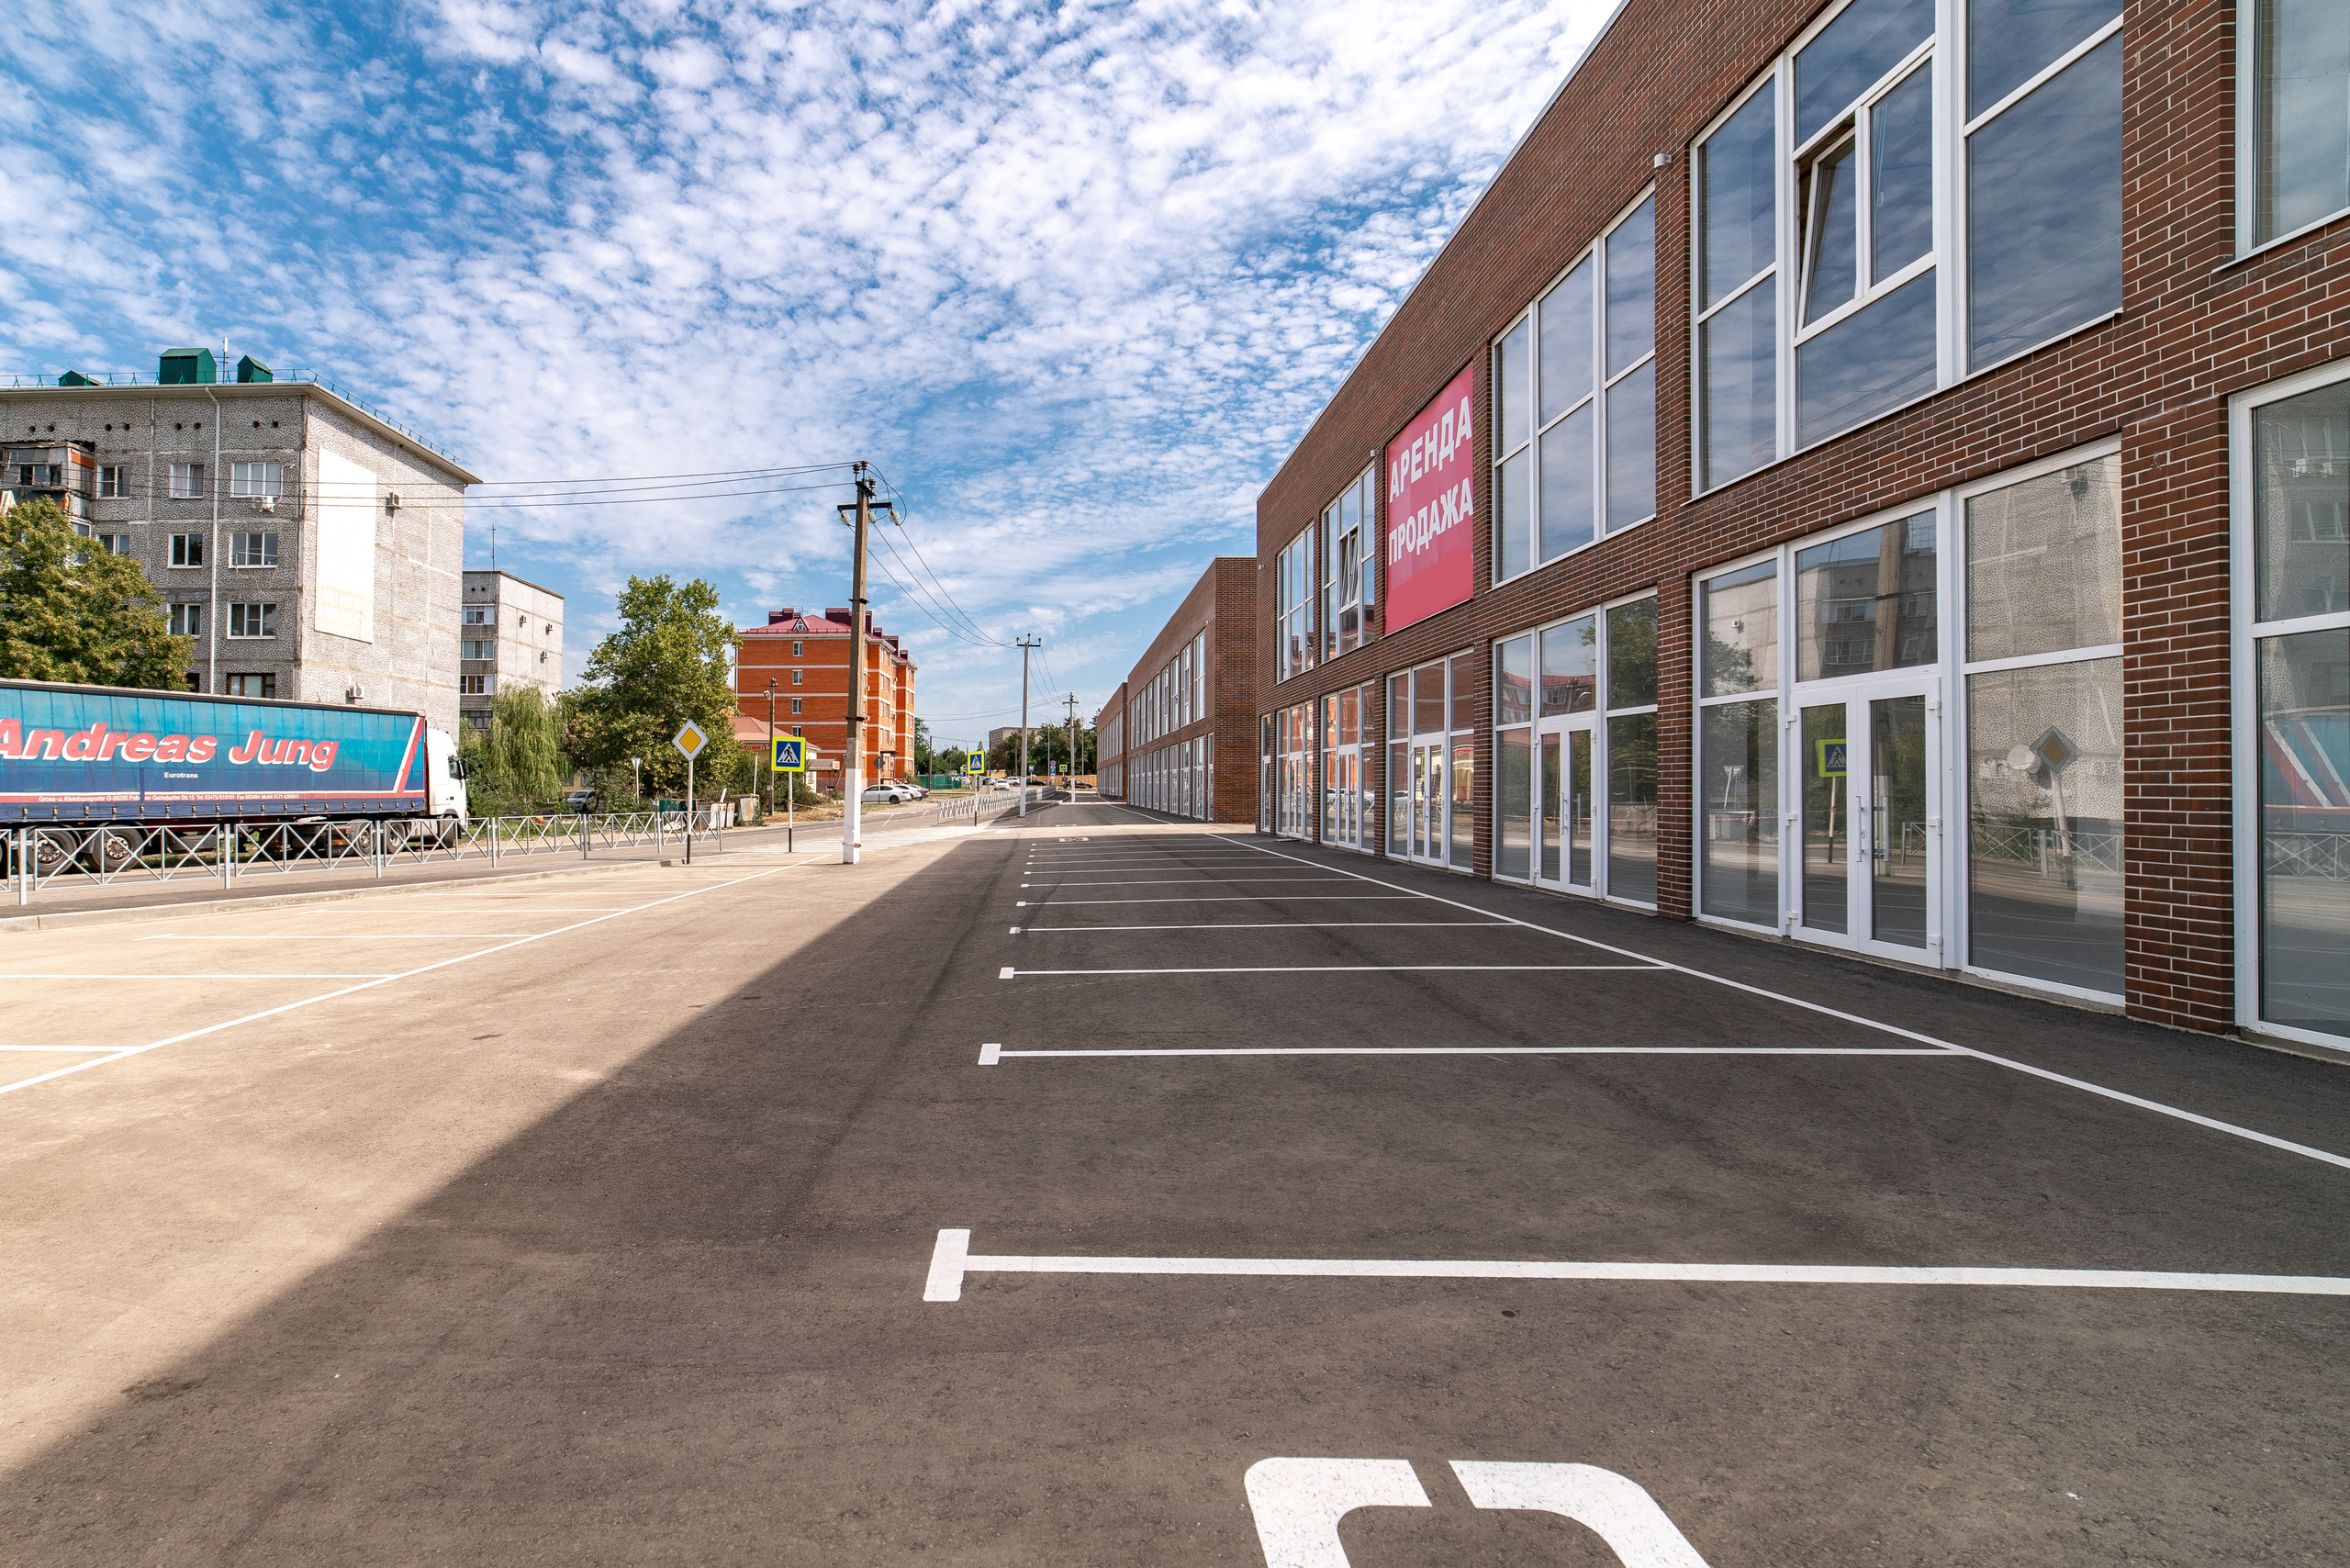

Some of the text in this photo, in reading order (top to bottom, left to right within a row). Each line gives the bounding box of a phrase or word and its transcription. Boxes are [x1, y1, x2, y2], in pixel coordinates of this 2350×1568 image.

[1389, 396, 1472, 504] АРЕНДА
[1388, 477, 1473, 566] ПРОДАЖА
[0, 719, 340, 772] Andreas Jung
[163, 771, 198, 779] Eurotrans
